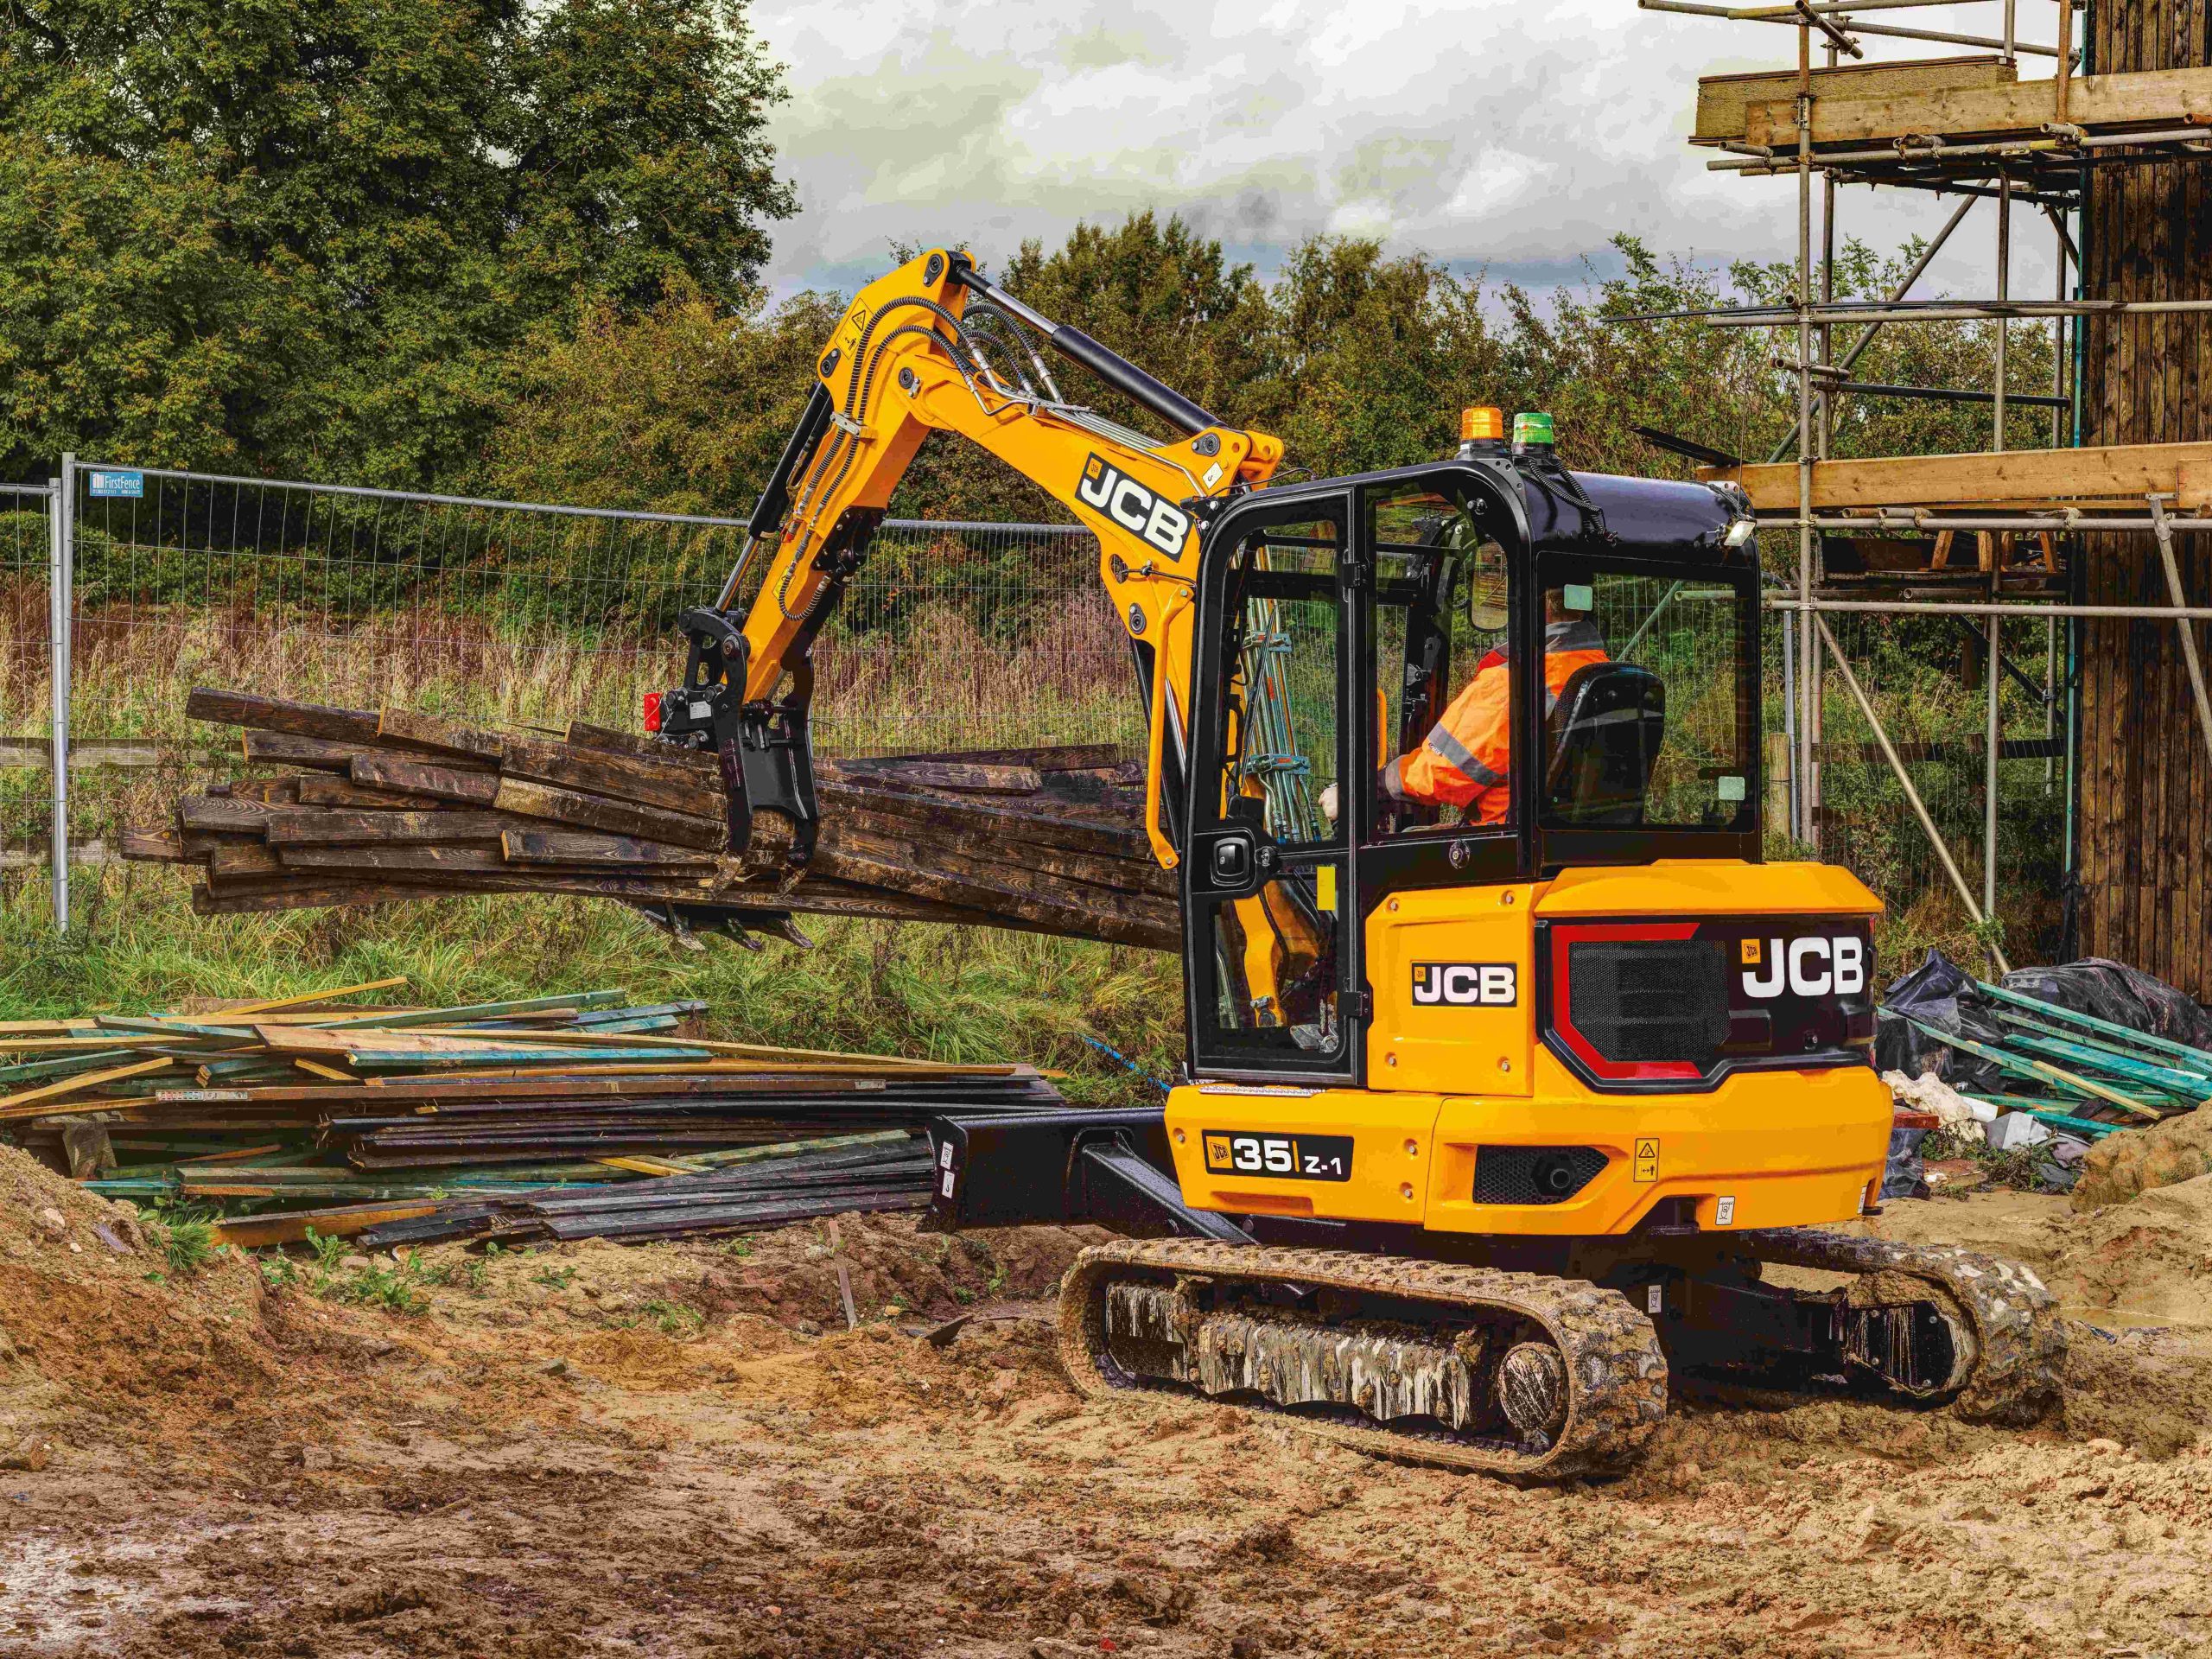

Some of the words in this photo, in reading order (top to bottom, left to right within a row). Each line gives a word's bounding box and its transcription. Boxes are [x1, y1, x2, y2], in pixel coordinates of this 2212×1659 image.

[105, 475, 140, 490] FirstFence
[1081, 468, 1188, 554] JCB
[1414, 966, 1516, 1003] JCB
[1741, 937, 1864, 998] JCB
[1233, 1138, 1293, 1172] 35
